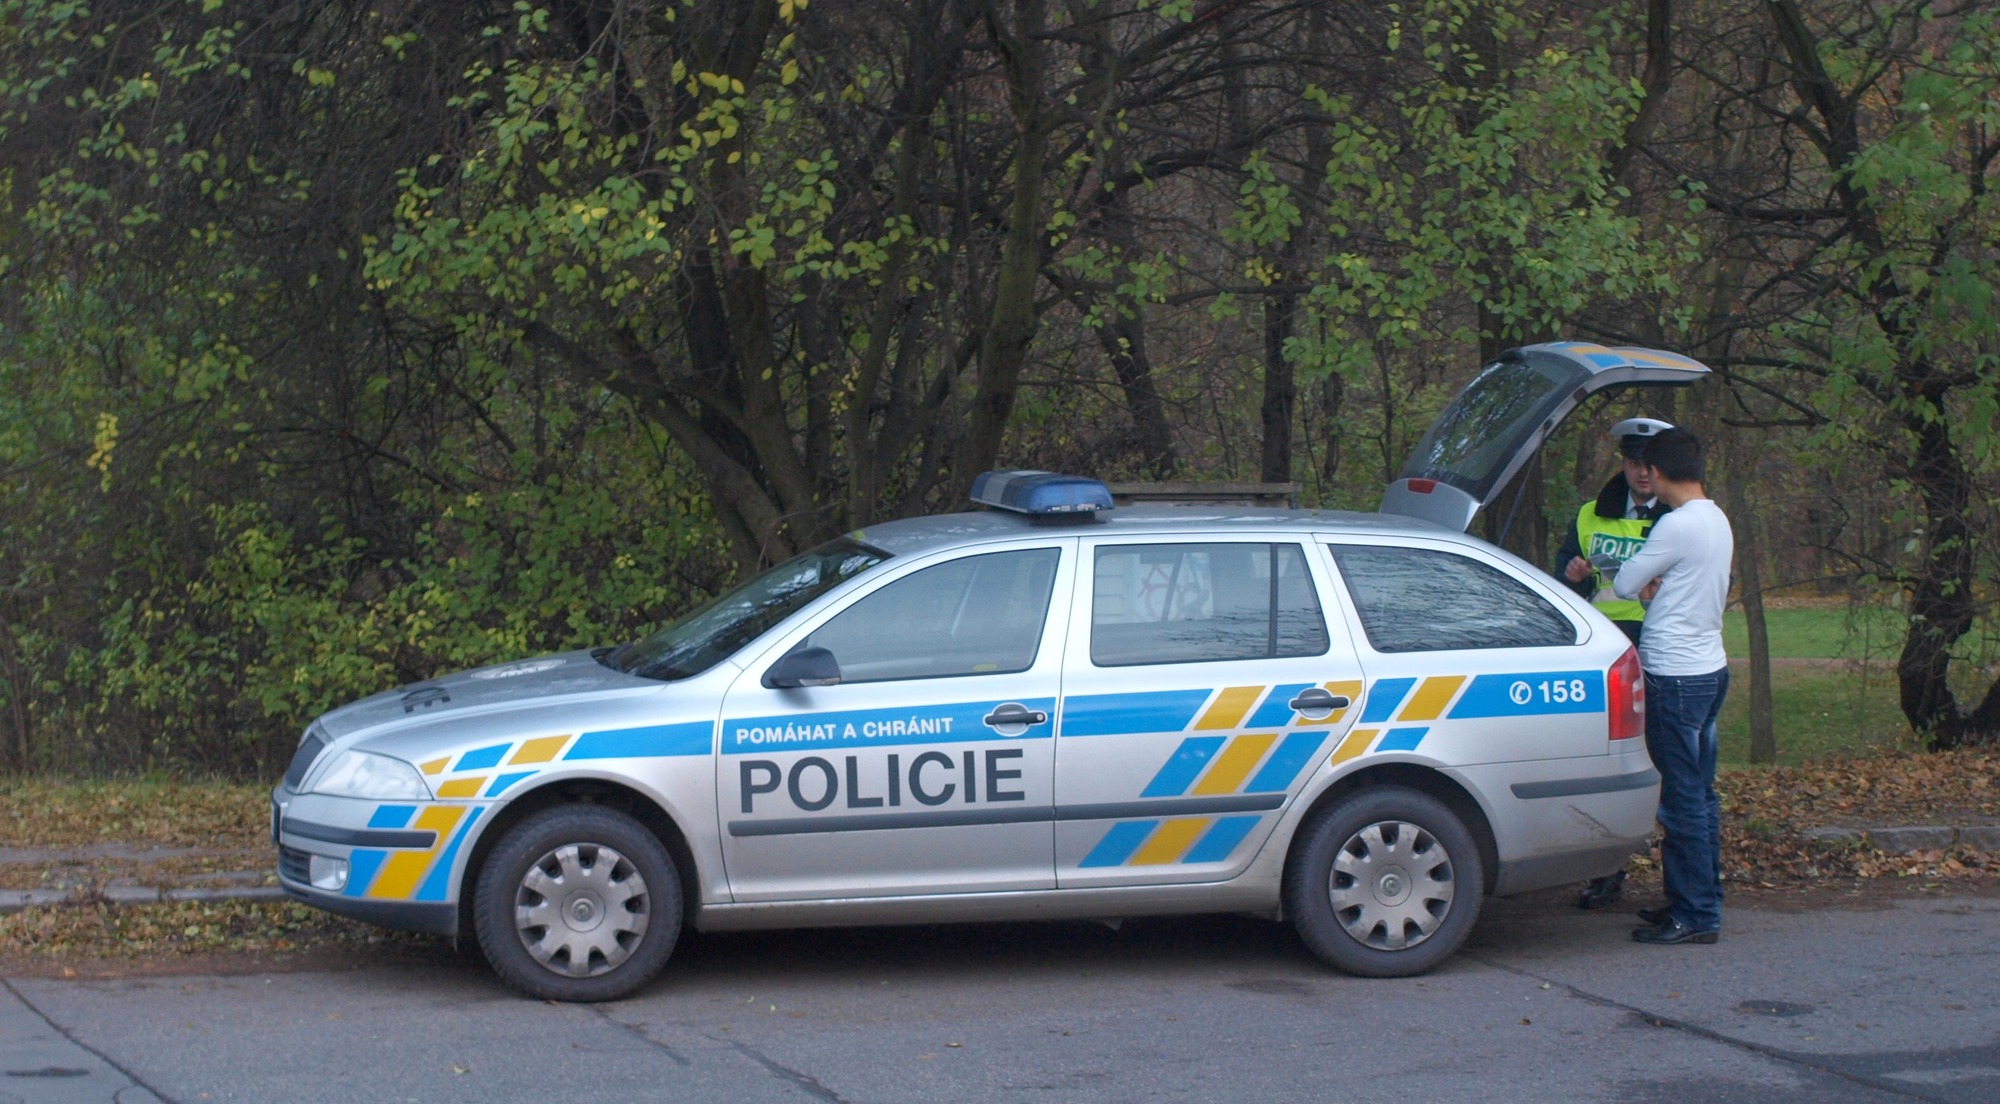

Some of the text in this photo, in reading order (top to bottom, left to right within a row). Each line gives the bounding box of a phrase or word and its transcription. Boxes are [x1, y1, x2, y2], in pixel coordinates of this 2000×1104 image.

[1538, 679, 1586, 703] 158
[736, 716, 953, 744] POMÁHAT A CHRÁNIT
[739, 749, 1026, 813] POLICIE
